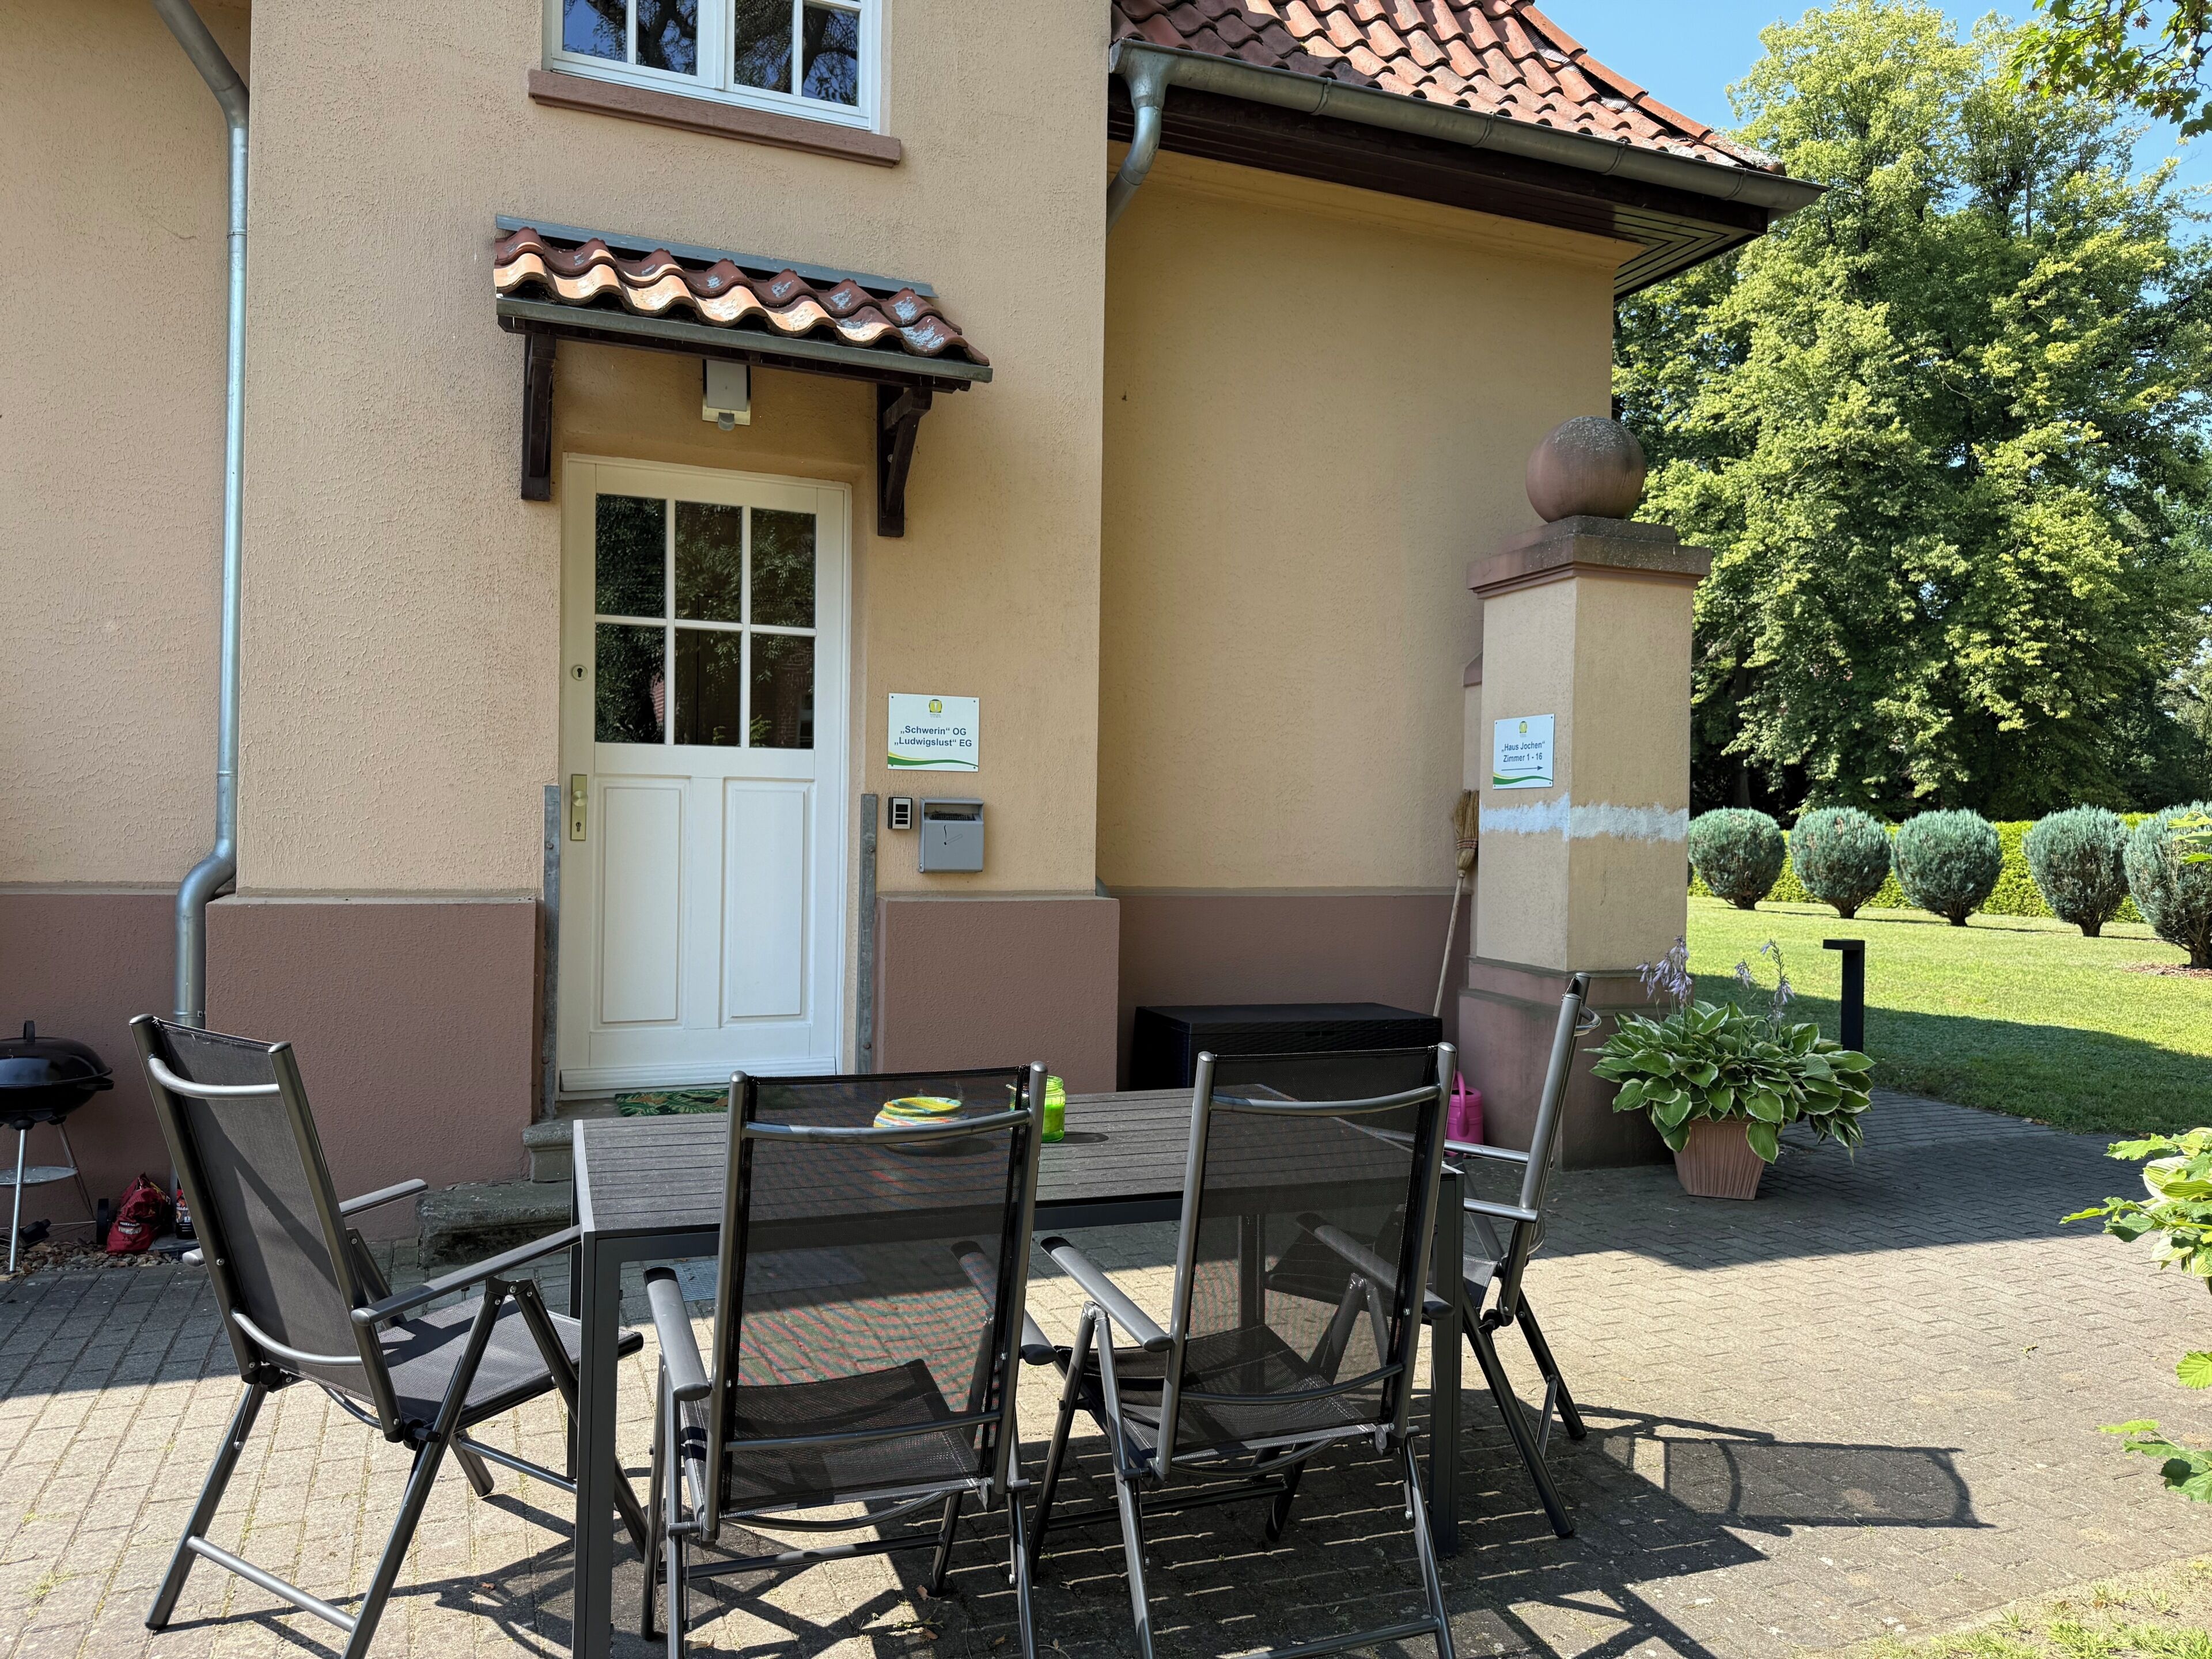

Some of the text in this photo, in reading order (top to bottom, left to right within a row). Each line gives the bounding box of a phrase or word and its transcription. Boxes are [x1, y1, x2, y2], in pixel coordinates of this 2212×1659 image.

[952, 728, 967, 736] OG
[959, 739, 972, 747] EG
[1536, 752, 1543, 760] 16
